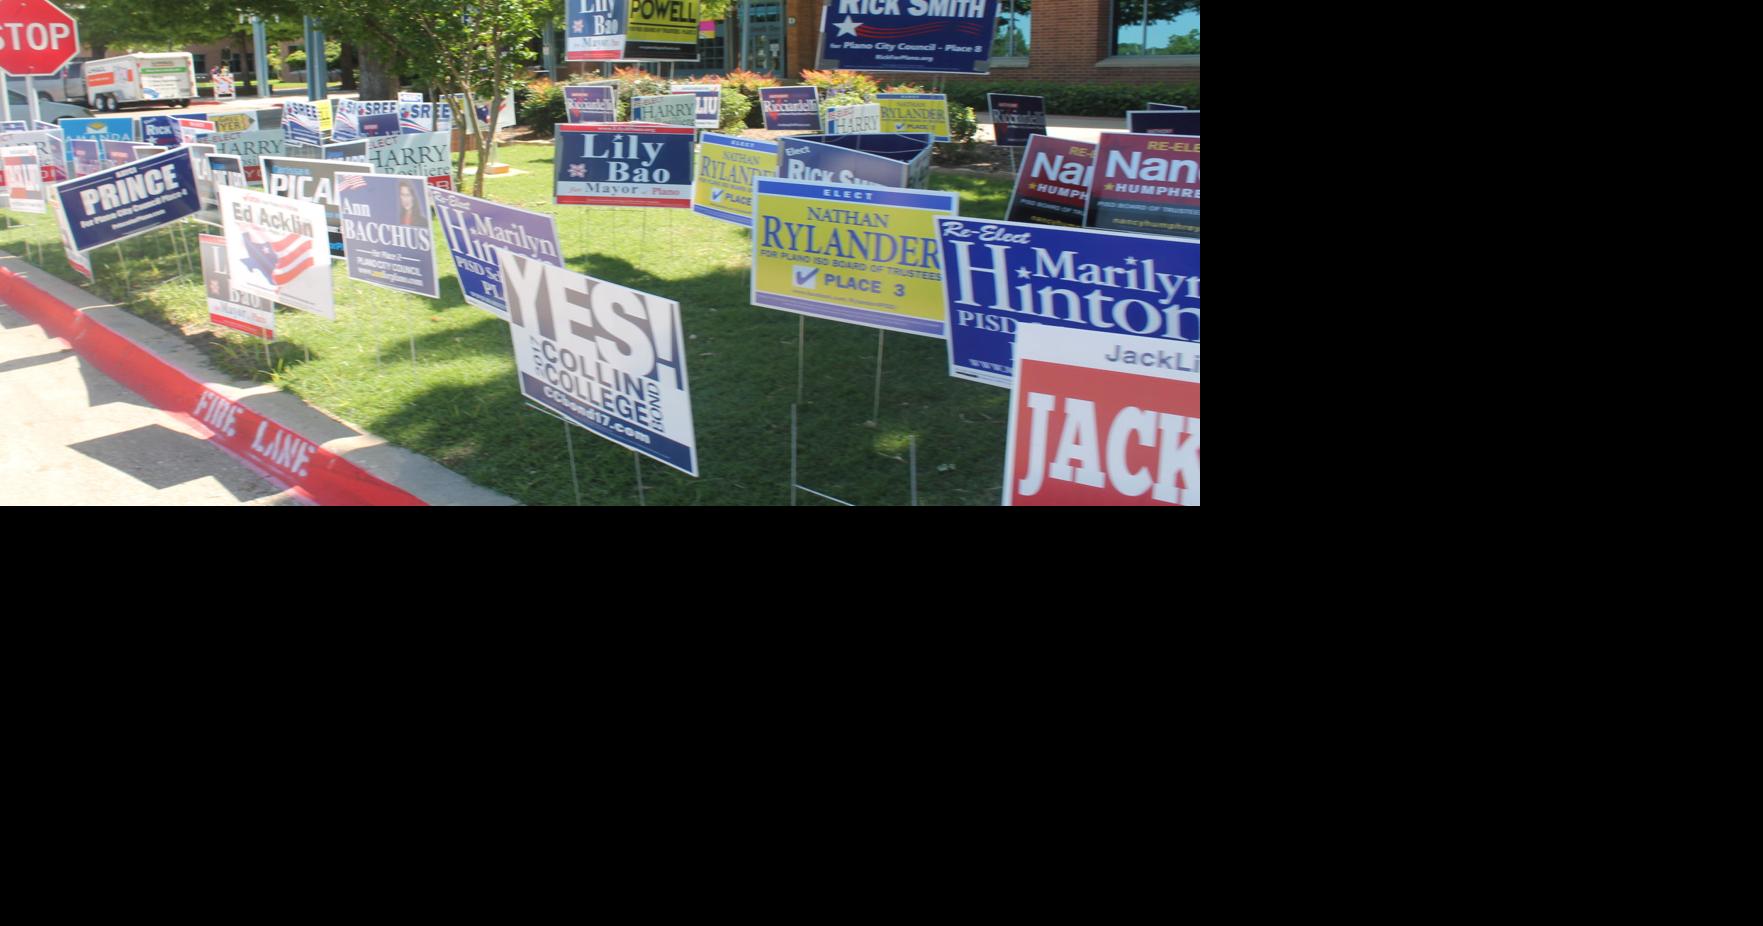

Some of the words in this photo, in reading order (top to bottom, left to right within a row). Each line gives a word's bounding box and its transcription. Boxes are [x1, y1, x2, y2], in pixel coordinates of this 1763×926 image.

[630, 0, 697, 23] POWELL
[906, 0, 986, 18] SMITH
[593, 15, 619, 36] Bao
[843, 41, 873, 50] Plano
[874, 42, 897, 52] City
[897, 43, 936, 52] Council
[944, 45, 973, 53] Place
[641, 103, 695, 119] HARRY
[695, 97, 719, 114] LIU
[764, 98, 819, 113] Ricciardelli
[880, 107, 947, 123] RYLANDER
[580, 133, 664, 167] Lily
[785, 146, 811, 157] Elect
[606, 161, 671, 184] Bao
[80, 164, 180, 216] PRINCE
[586, 182, 639, 196] Mayor
[823, 188, 875, 201] ELECT
[342, 197, 371, 218] Ann
[806, 206, 889, 229] NATHAN
[231, 201, 254, 223] Ed
[259, 207, 314, 239] Acklin
[344, 218, 432, 252] BACCHUS
[471, 213, 560, 259] Marilyn
[761, 214, 942, 270] RYLANDER
[942, 220, 1033, 246] Re-Elect
[781, 251, 811, 264] PLANO
[831, 258, 868, 272] BOARD
[823, 273, 882, 295] PLACE
[893, 282, 907, 298] 3
[541, 340, 646, 402] COLLIN
[544, 362, 650, 428] COLLEGE
[193, 391, 244, 438] FIRE
[251, 420, 317, 478] LANE
[1018, 391, 1200, 506] JACK
